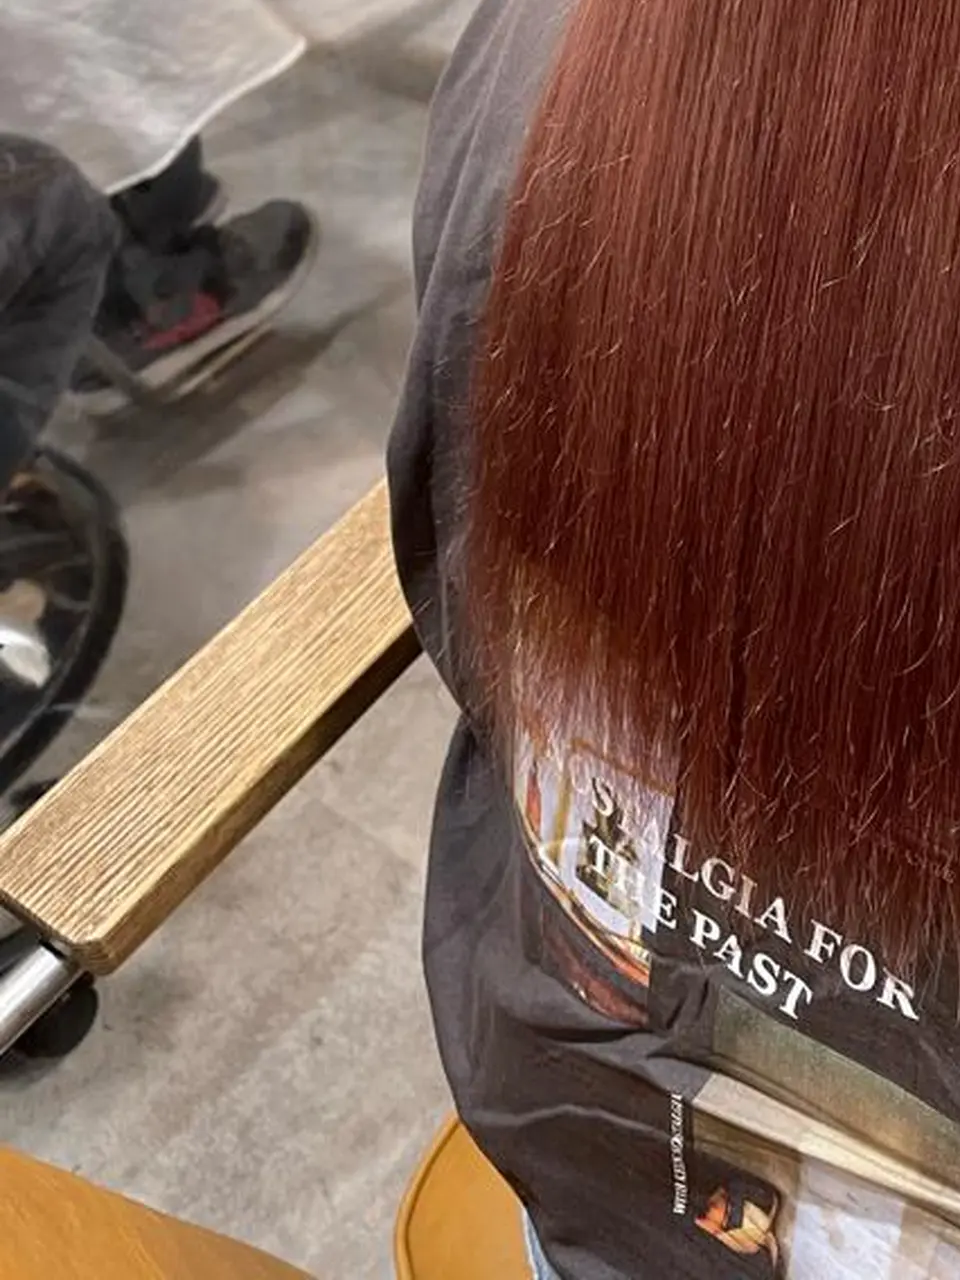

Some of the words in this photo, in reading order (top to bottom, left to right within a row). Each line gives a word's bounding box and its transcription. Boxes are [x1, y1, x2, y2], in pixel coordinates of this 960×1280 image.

[588, 835, 678, 929] THE
[689, 910, 813, 1020] PAST
[803, 919, 920, 1021] FOR
